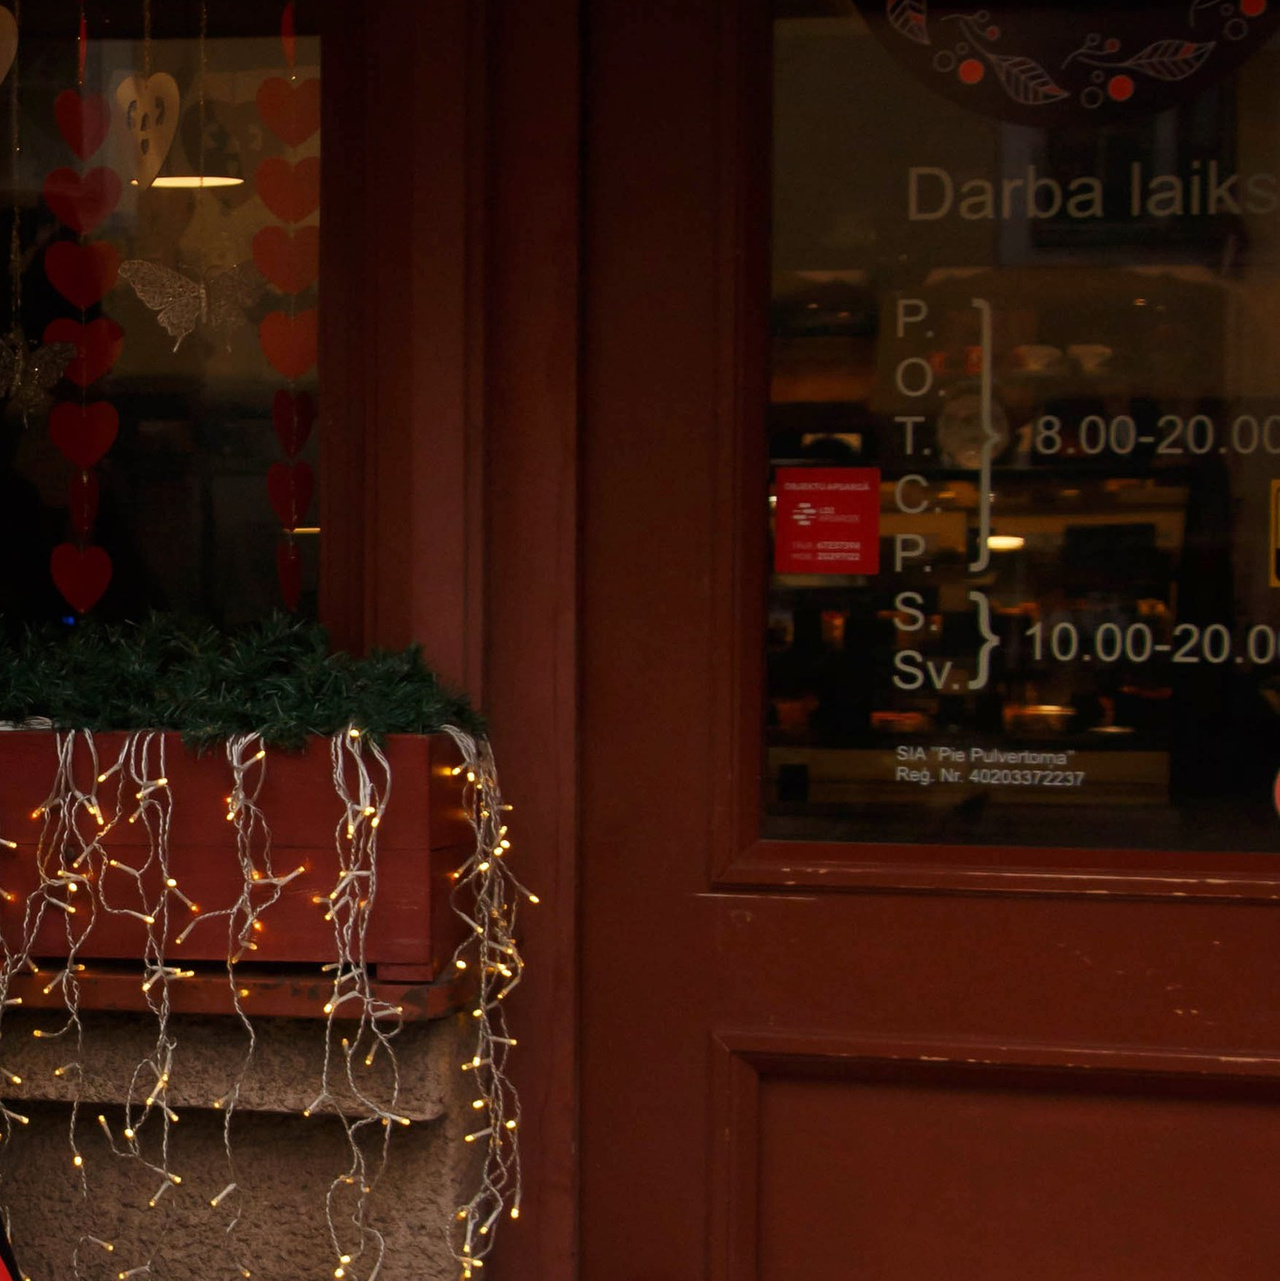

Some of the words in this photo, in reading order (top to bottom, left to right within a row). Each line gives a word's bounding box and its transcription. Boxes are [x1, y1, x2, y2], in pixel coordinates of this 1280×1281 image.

[907, 165, 1104, 220] Darba
[1131, 159, 1278, 218] laiks
[896, 299, 934, 339] P.
[895, 357, 946, 397] O.
[895, 416, 932, 456] T.
[895, 474, 942, 514] C.
[895, 534, 932, 573] P.
[893, 591, 939, 632] S.
[1024, 622, 1280, 664] 10.00-20.0
[892, 650, 960, 690] Sv.
[896, 745, 927, 761] SIA
[930, 746, 966, 762] "Pie
[940, 768, 963, 783] Nr.
